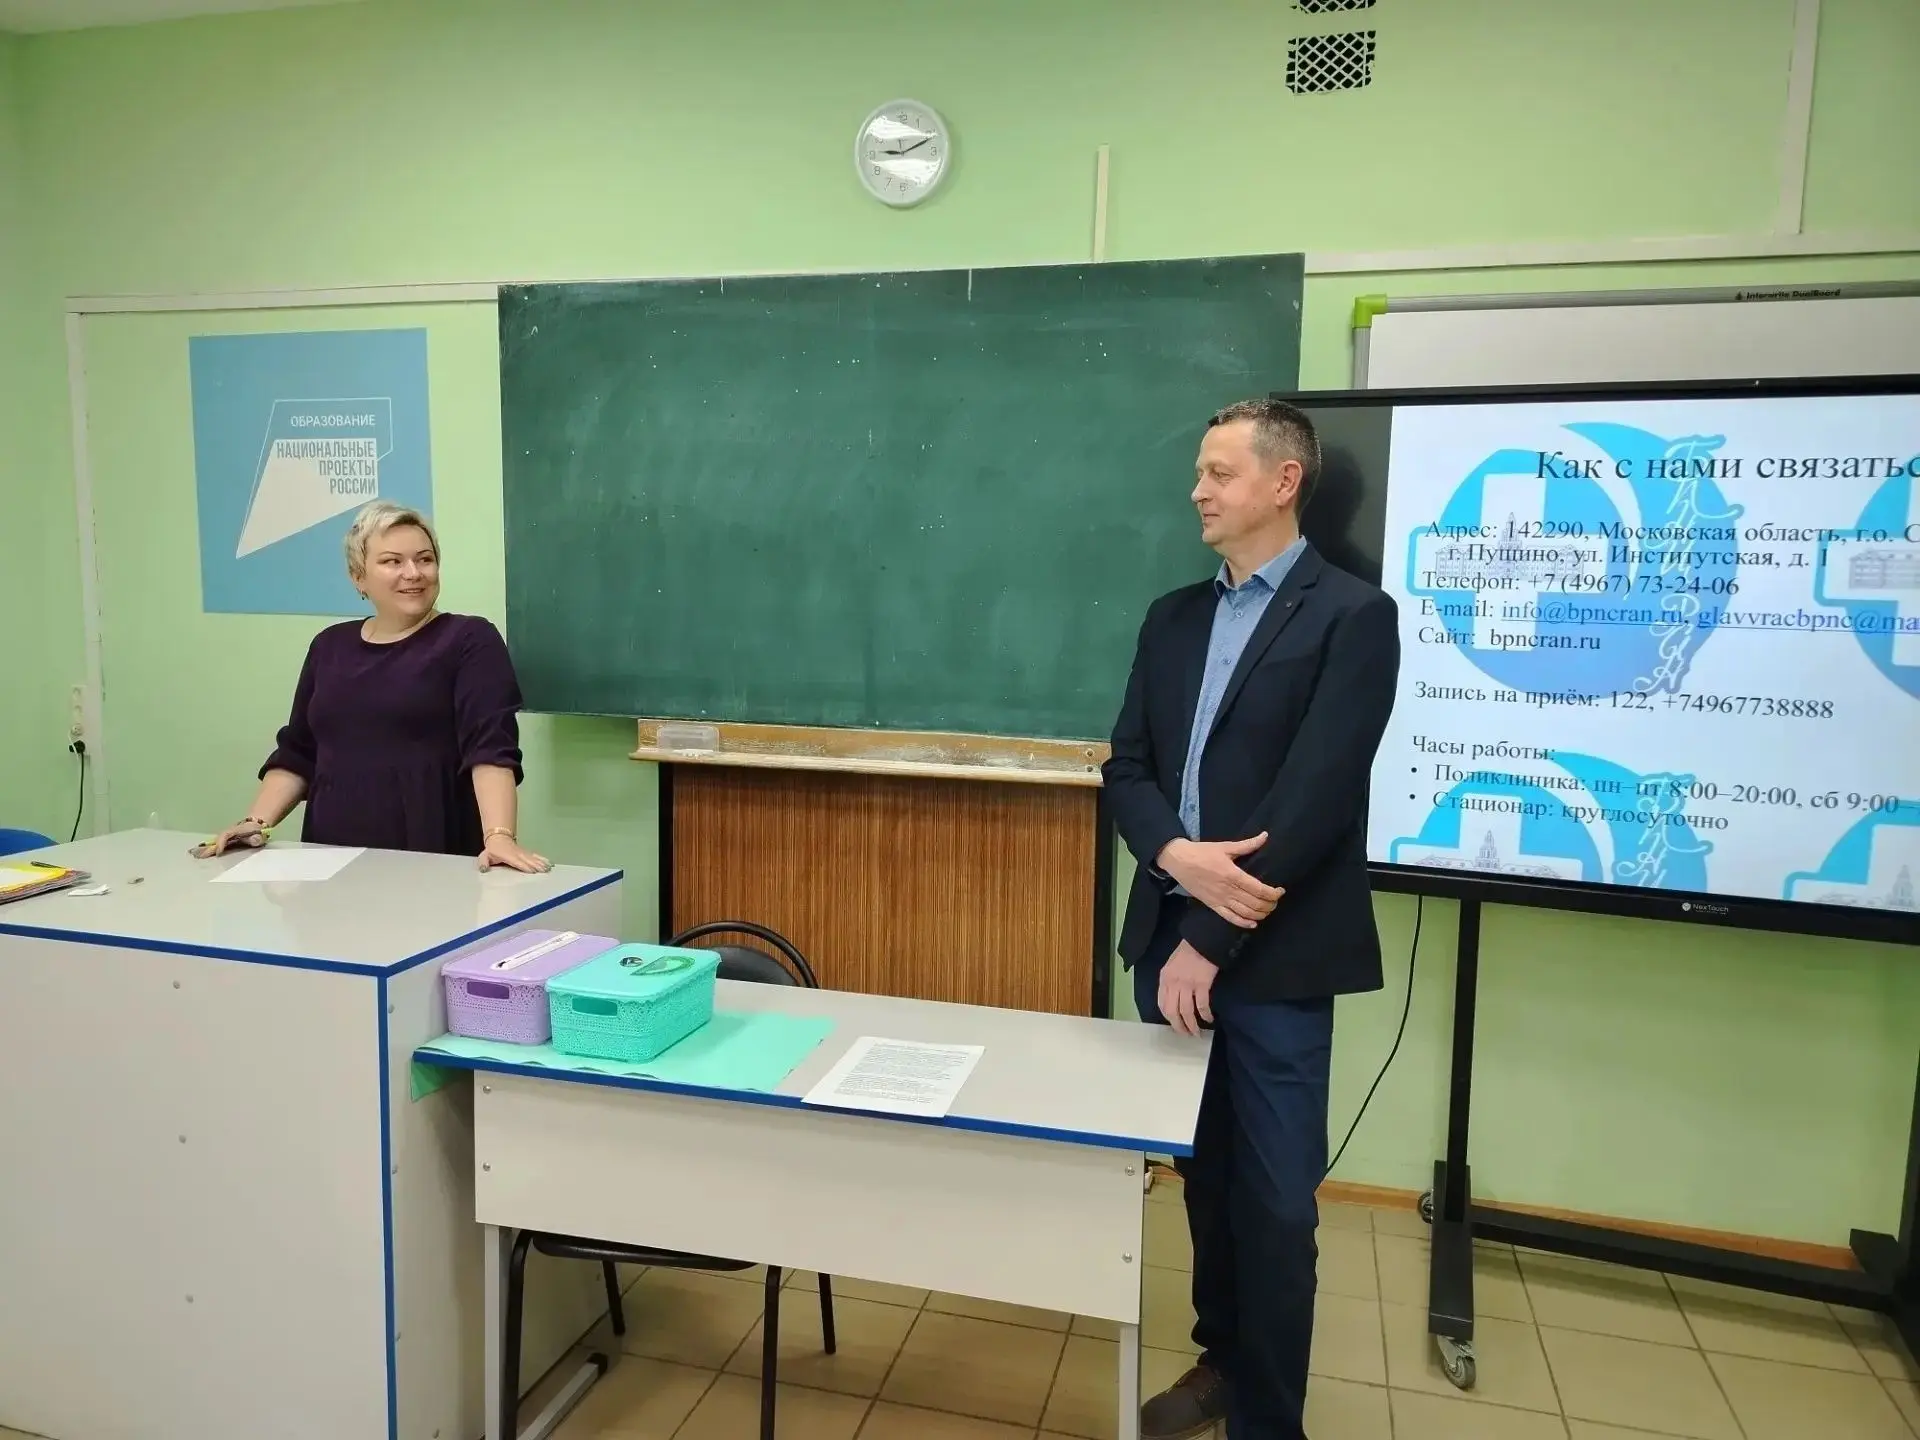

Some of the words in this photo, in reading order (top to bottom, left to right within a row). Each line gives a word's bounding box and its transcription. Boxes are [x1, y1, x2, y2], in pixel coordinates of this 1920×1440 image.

[290, 414, 376, 427] ОБРАЗОВАНИЕ
[276, 440, 374, 460] НАЦИОНАЛЬНЫЕ
[319, 459, 375, 477] ПРОЕКТЫ
[1535, 450, 1603, 479] Как
[1614, 457, 1633, 479] с
[1645, 457, 1743, 479] нами
[329, 477, 376, 495] РОССИИ
[1424, 521, 1498, 542] Адрес:
[1507, 520, 1590, 541] 142290,
[1597, 521, 1737, 542] Московская
[1744, 522, 1847, 544] область,
[1856, 528, 1894, 543] г.о.
[1468, 543, 1565, 565] Пущино,
[1572, 549, 1604, 567] ул.
[1611, 544, 1781, 569] Институтская,
[1788, 551, 1811, 567] д.
[1422, 571, 1520, 593] Телефон:
[1527, 573, 1556, 591] +7
[1561, 573, 1632, 594] (4967)
[1638, 574, 1740, 595] 73-24-06
[1421, 599, 1494, 618] E-mail:
[1501, 600, 1690, 626] info@bpncran.ru,
[1418, 626, 1476, 645] Сайт:
[1490, 628, 1601, 651] bpncran.ru
[1415, 681, 1487, 702] Запись
[1493, 688, 1518, 703] на
[1525, 689, 1600, 709] приём:
[1611, 690, 1655, 712] 122,
[1663, 693, 1834, 719] +74967738888
[1412, 735, 1465, 755] Часы
[1472, 740, 1556, 761] работы:
[1434, 763, 1586, 791] Поликлиника:
[1810, 790, 1840, 809] сб
[1432, 790, 1553, 818] Стационар:
[1561, 803, 1729, 830] круглосуточно
